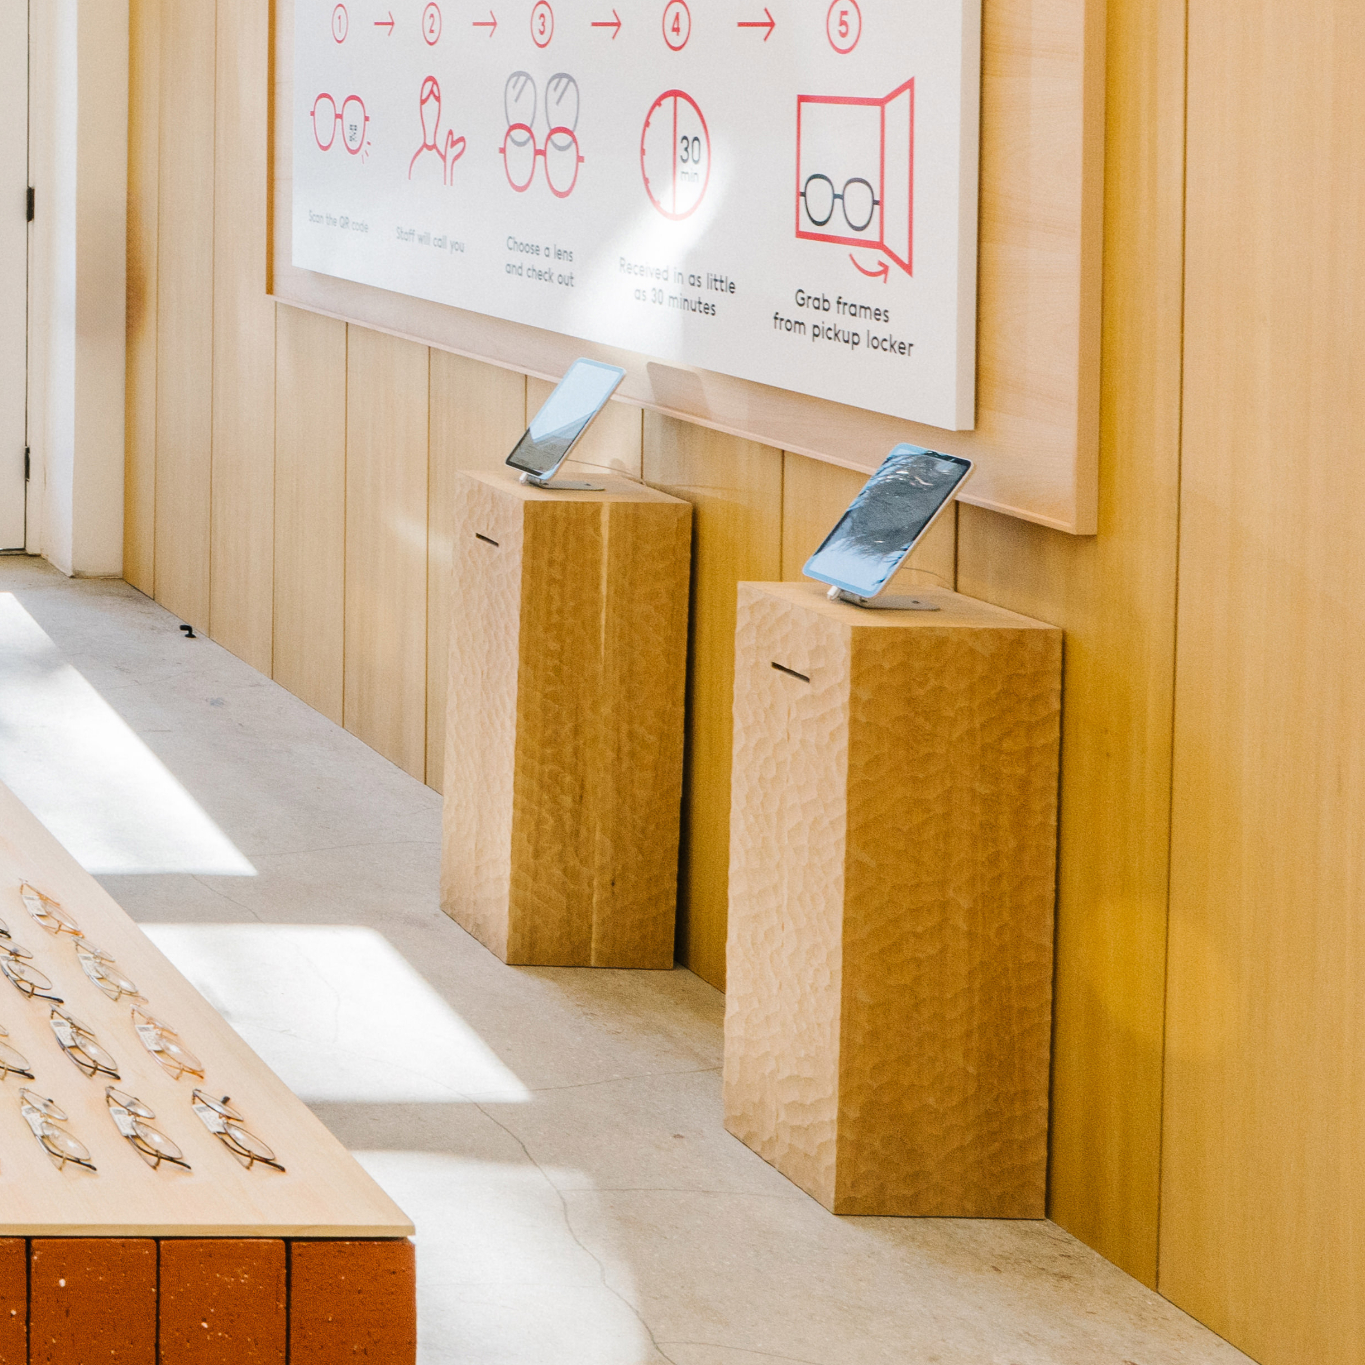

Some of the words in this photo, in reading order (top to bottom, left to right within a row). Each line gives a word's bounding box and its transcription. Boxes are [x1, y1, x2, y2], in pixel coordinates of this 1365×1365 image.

[679, 135, 701, 164] 30
[309, 210, 325, 224] Scan
[325, 212, 337, 227] the
[339, 215, 350, 230] QR
[351, 218, 369, 234] code
[396, 226, 415, 242] Staff
[417, 232, 431, 246] will
[432, 235, 447, 250] call
[449, 239, 465, 254] you
[506, 236, 541, 256] Choose
[544, 246, 550, 258] a
[553, 244, 574, 262] lens
[505, 262, 523, 277] and
[526, 264, 555, 284] check
[557, 272, 575, 288] out
[619, 256, 669, 282] Received
[673, 266, 684, 284] in
[689, 274, 702, 288] as
[706, 272, 736, 294] little
[633, 288, 647, 302] as
[651, 287, 664, 306] 30
[668, 292, 716, 316] minutes
[795, 288, 831, 312] Grab
[836, 296, 890, 323] frames
[773, 312, 807, 336] from
[812, 320, 861, 350] pickup
[867, 329, 915, 357] locker
